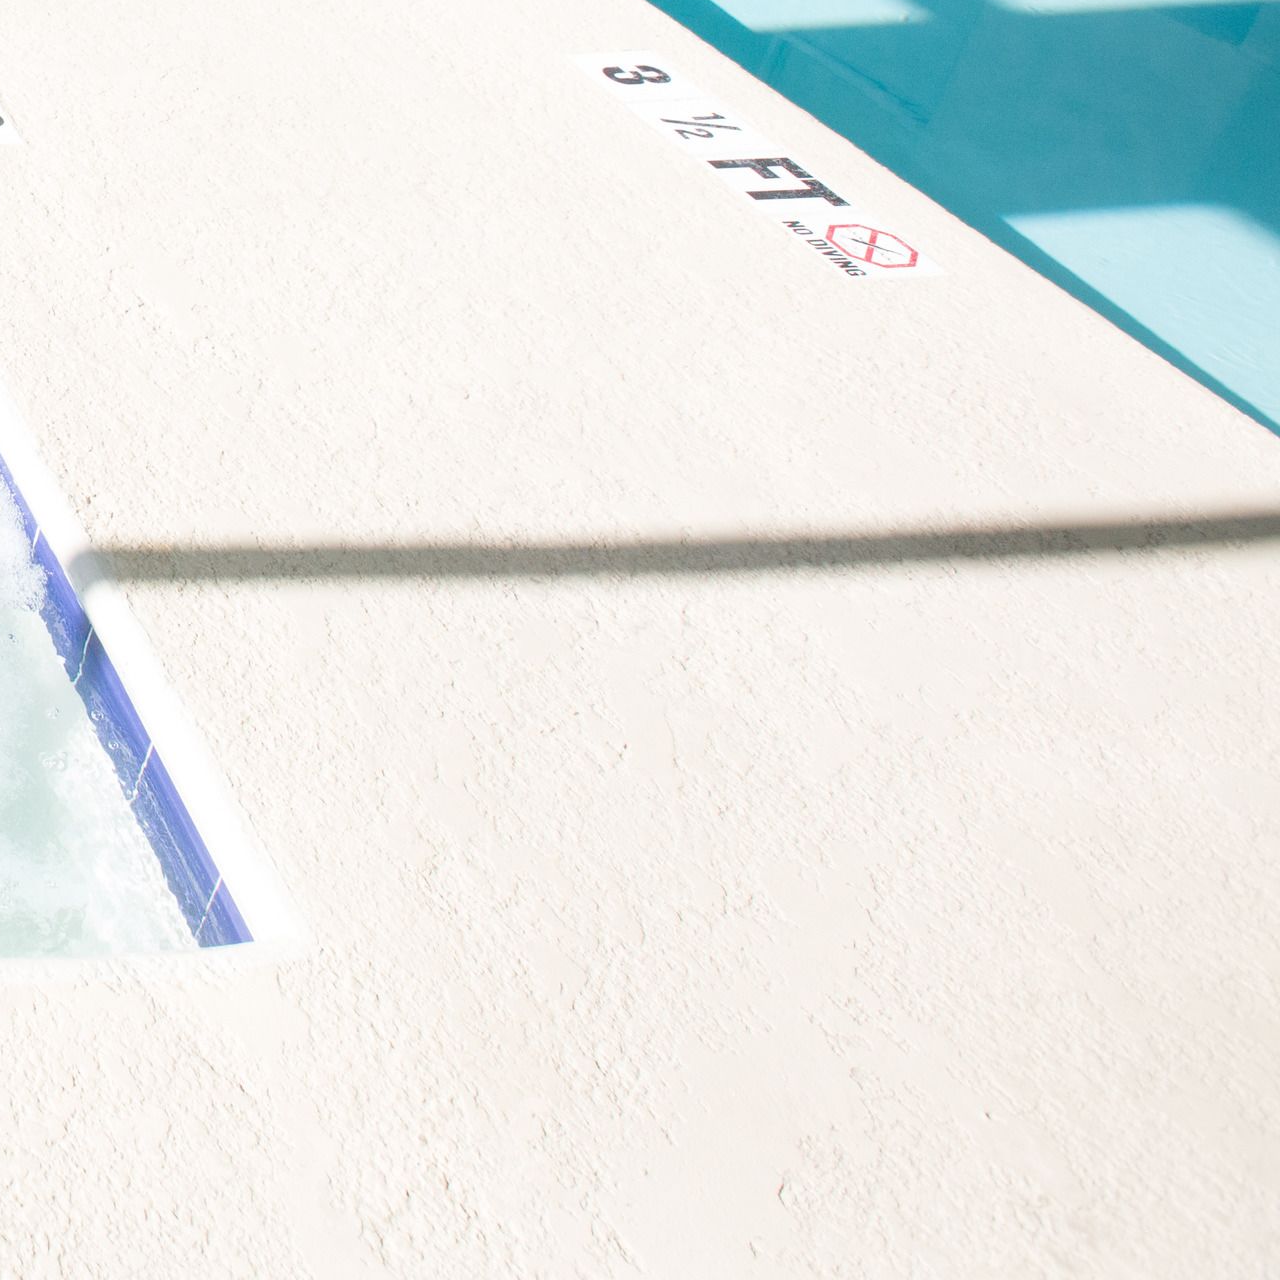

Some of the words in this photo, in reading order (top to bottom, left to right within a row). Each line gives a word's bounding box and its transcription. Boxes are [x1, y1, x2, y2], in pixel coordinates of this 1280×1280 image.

[602, 65, 671, 85] 3
[707, 157, 851, 207] FT
[782, 220, 813, 236] NO
[806, 238, 866, 277] DIVING
